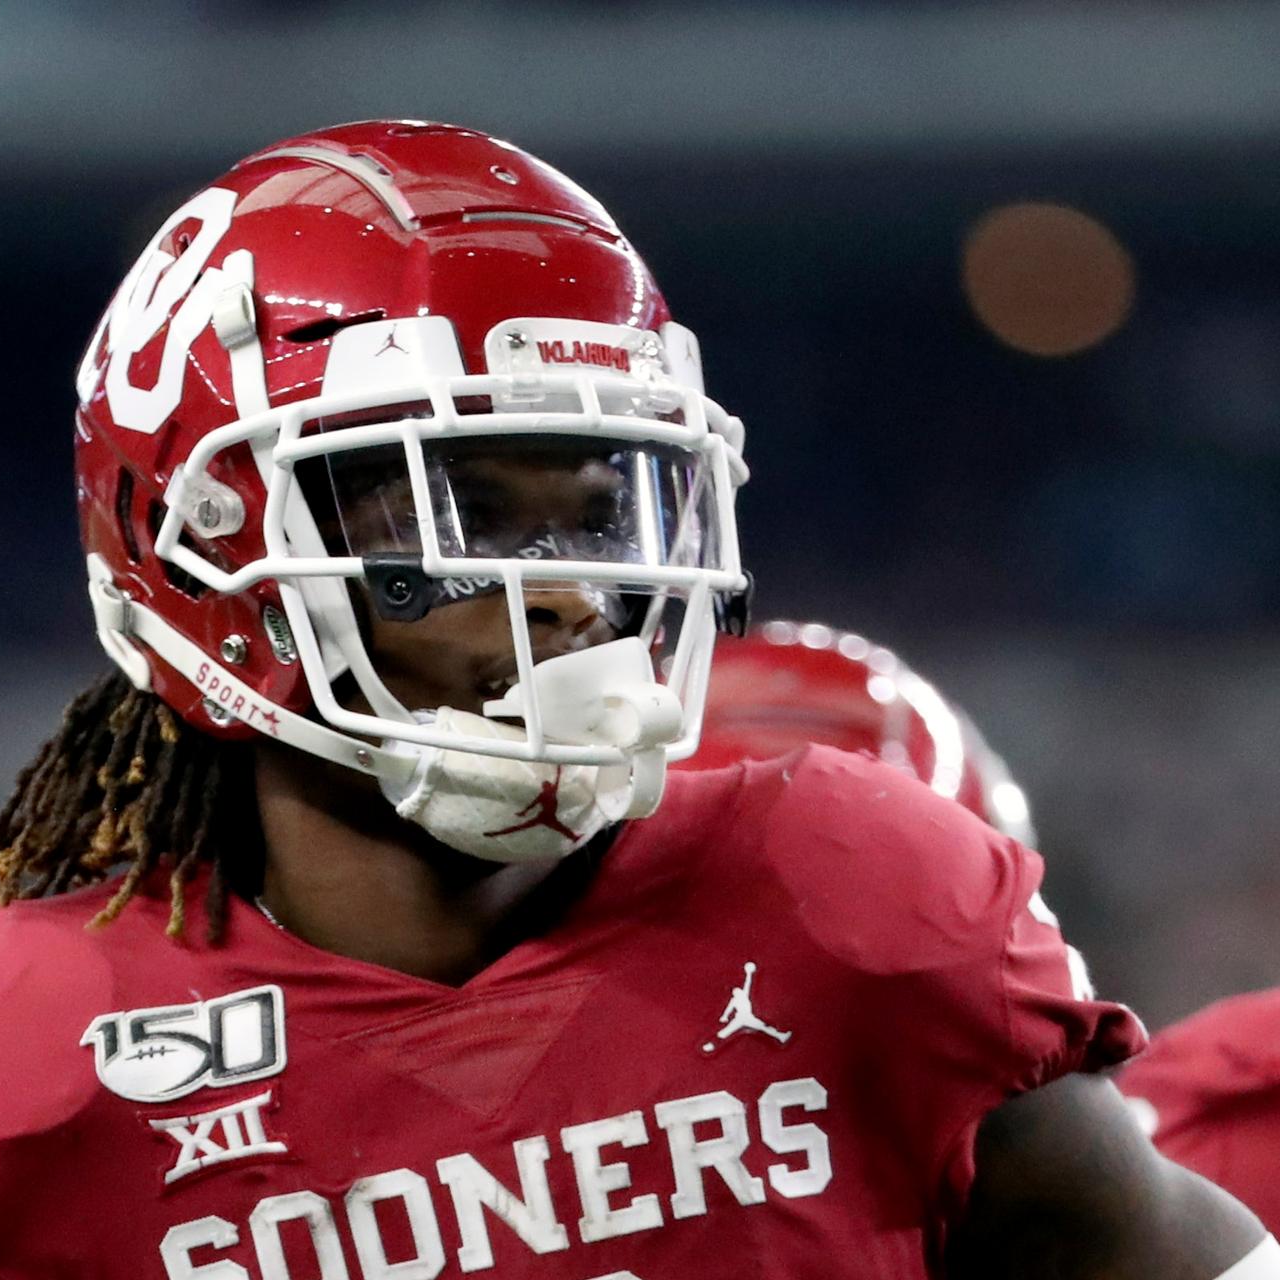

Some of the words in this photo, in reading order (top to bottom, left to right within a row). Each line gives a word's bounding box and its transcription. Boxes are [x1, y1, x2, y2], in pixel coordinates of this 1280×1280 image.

[196, 662, 259, 720] SPORT
[85, 987, 283, 1098] 150
[148, 1089, 288, 1185] XII
